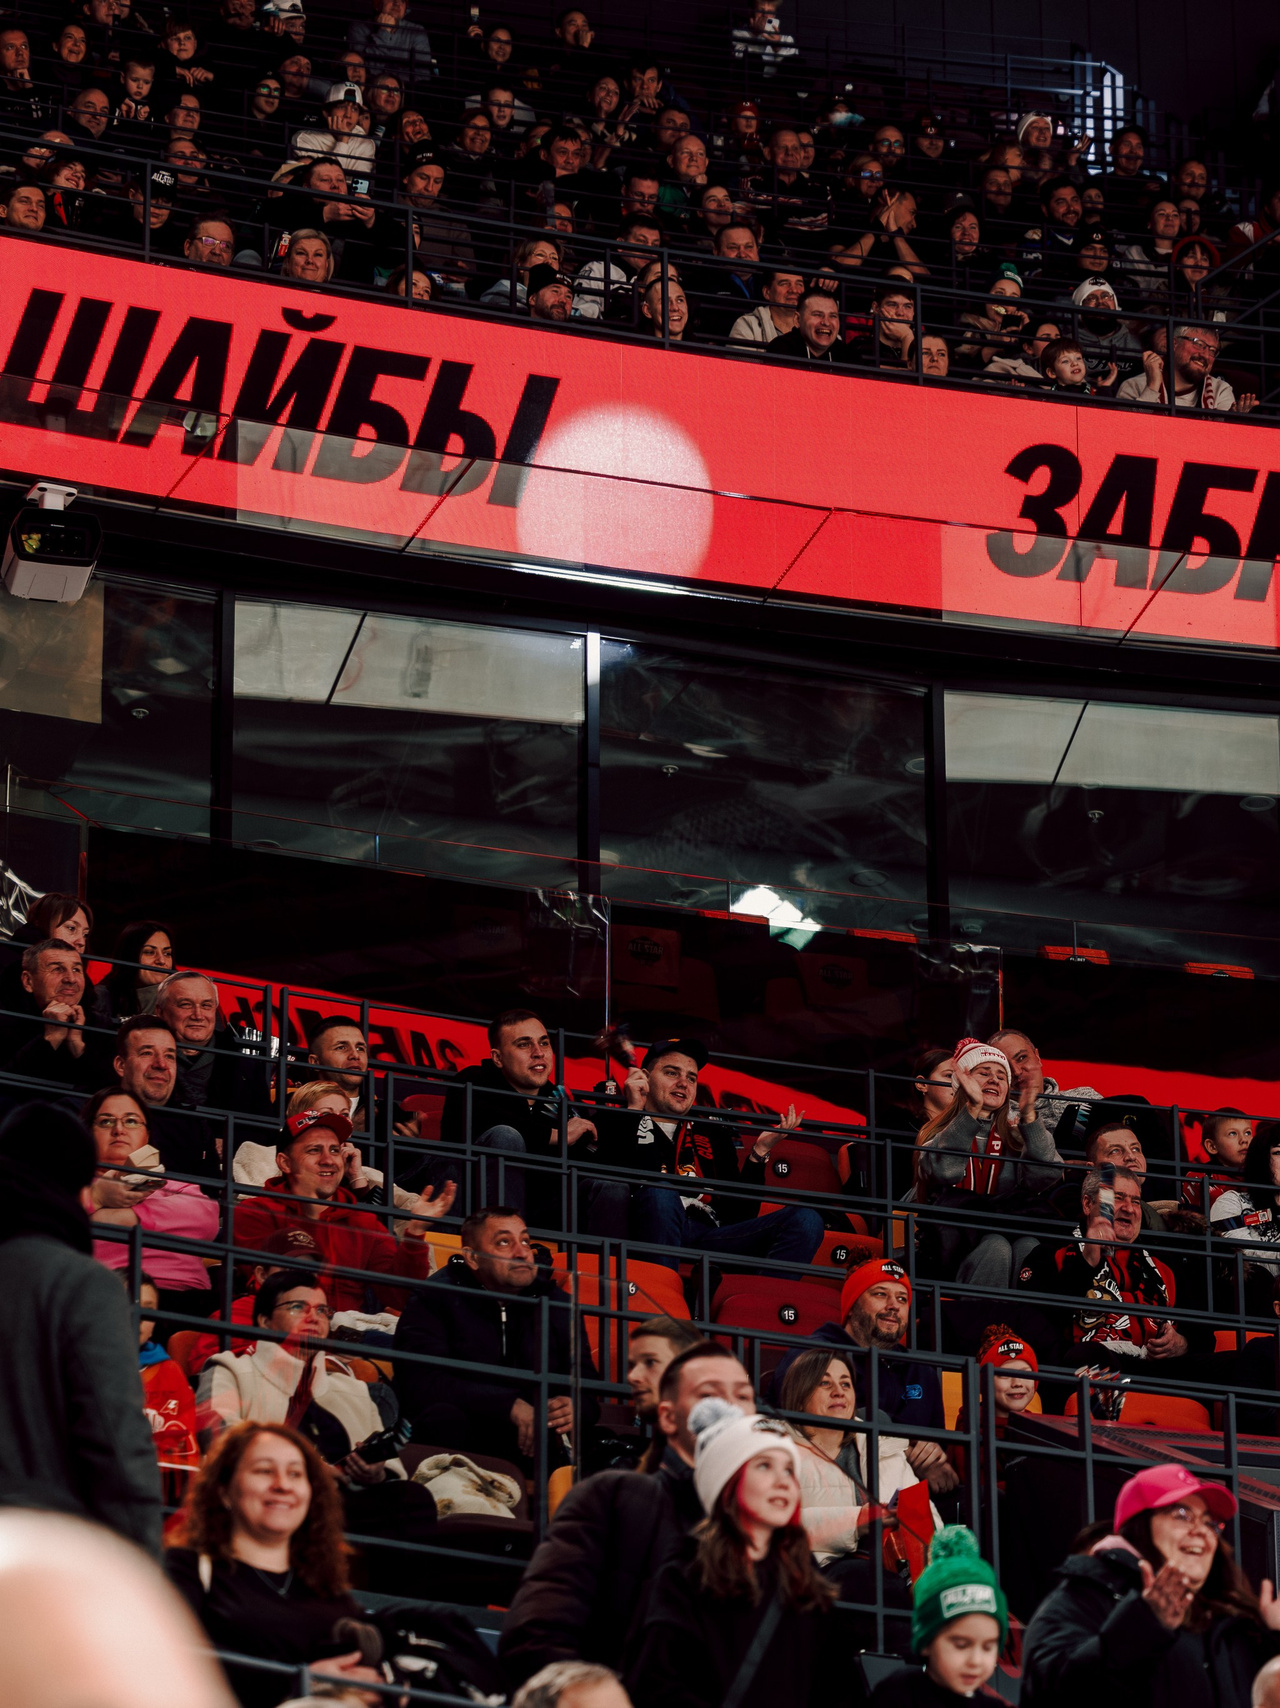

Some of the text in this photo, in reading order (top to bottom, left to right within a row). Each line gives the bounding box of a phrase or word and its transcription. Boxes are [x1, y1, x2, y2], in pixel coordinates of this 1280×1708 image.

[0, 288, 561, 509] ШАЙБЫ
[694, 1134, 714, 1160] CLUB
[777, 1163, 788, 1174] 15
[836, 1249, 847, 1260] 15
[784, 1310, 795, 1321] 15
[998, 1342, 1024, 1353] ALL STAR
